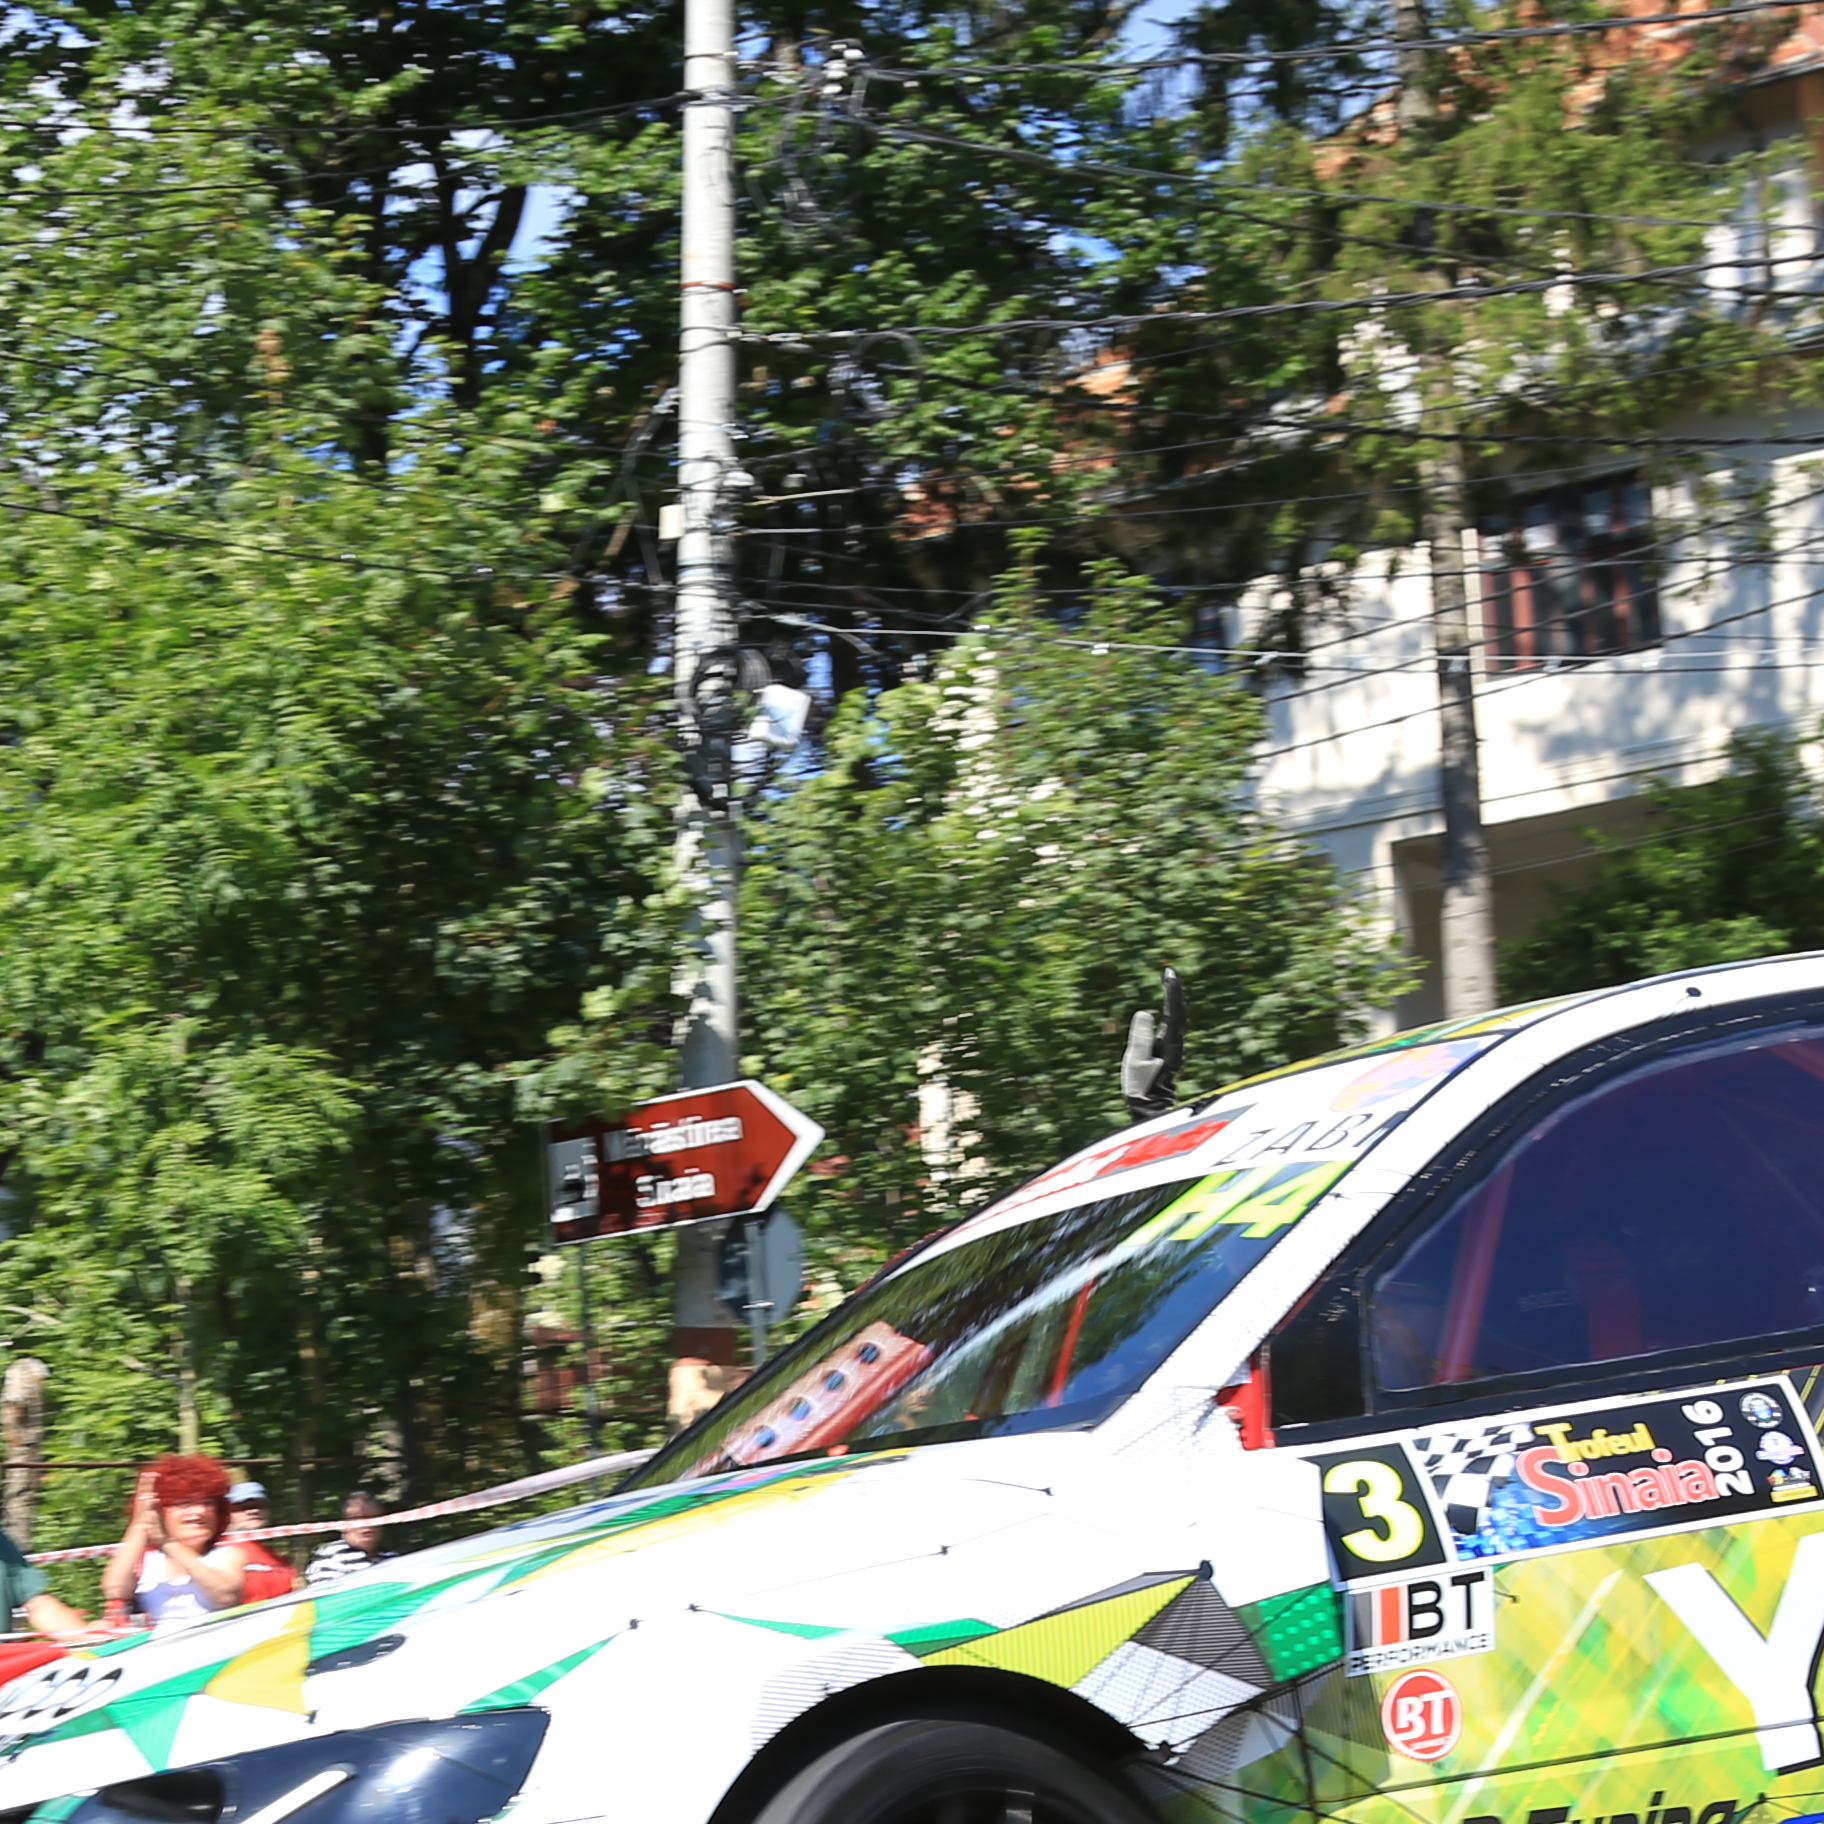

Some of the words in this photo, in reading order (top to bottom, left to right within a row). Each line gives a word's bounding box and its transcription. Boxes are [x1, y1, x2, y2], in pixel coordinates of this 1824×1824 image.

[1116, 1160, 1356, 1247] H4
[1534, 1422, 1657, 1463] Trofeul
[1680, 1400, 1756, 1497] 2016
[1323, 1460, 1425, 1563] 3
[1516, 1445, 1721, 1527] Sinaia
[1390, 1689, 1457, 1743] BT
